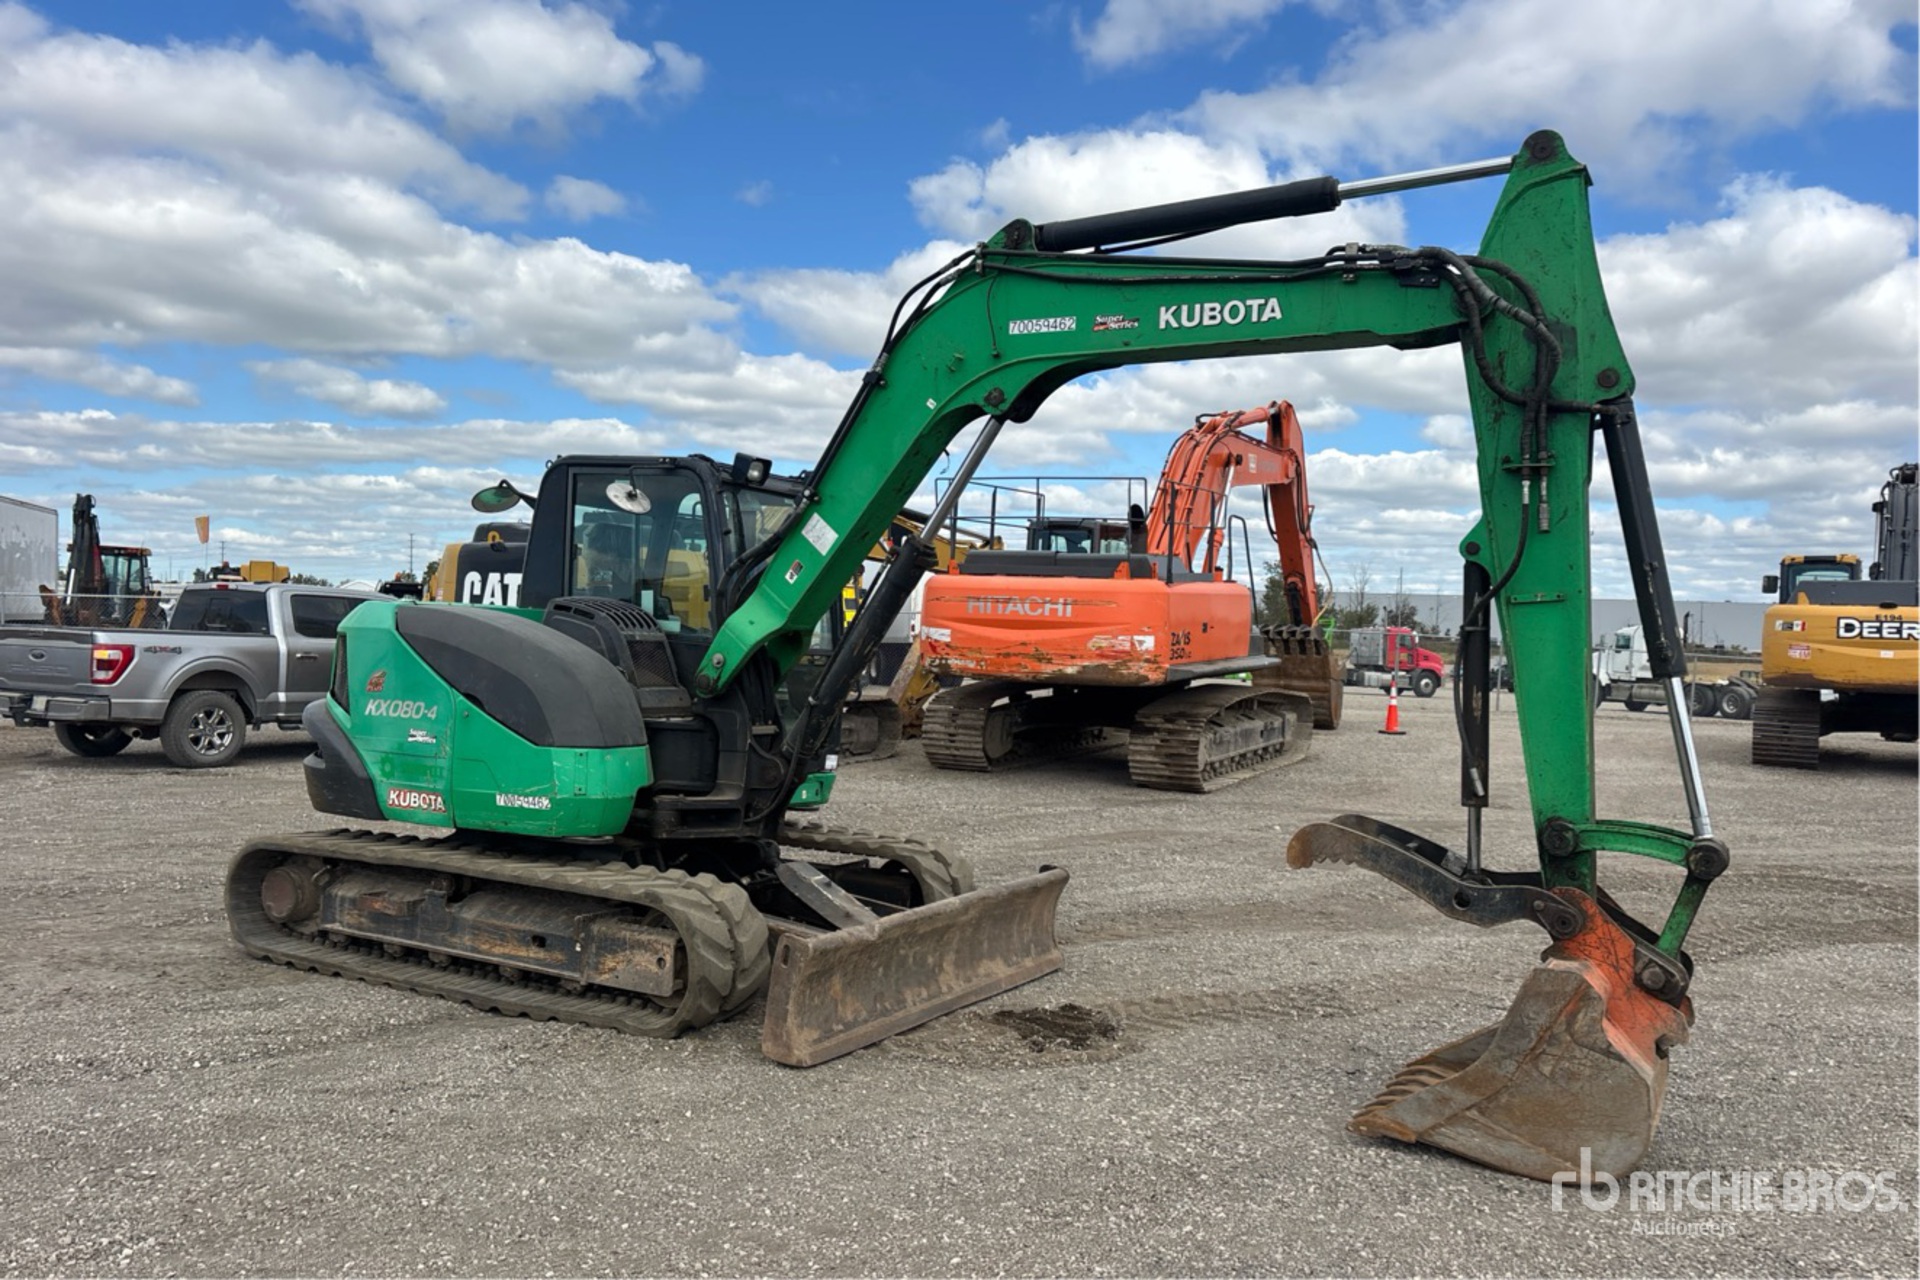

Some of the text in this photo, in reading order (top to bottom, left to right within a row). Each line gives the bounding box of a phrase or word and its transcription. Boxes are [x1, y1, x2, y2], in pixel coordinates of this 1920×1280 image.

[1095, 314, 1124, 324] Super
[1159, 298, 1282, 329] KUBOTA
[1010, 317, 1076, 333] 70059462
[1108, 319, 1139, 330] Series
[463, 571, 523, 606] CAT
[967, 596, 1073, 617] HITACHI
[365, 699, 438, 720] KX080-4
[388, 789, 446, 812] KUBOTA
[498, 794, 551, 810] 70059462
